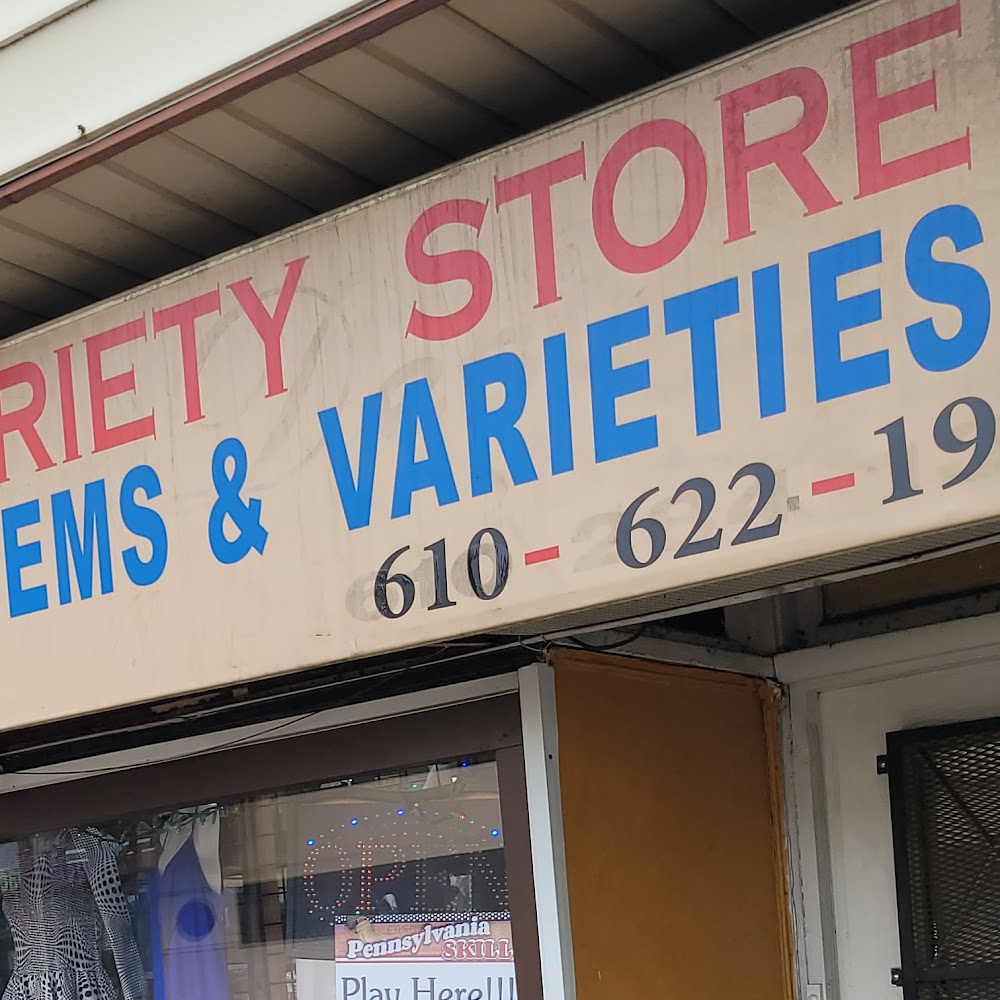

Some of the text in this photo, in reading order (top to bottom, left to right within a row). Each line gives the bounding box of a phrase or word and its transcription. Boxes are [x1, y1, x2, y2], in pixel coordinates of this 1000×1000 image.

[405, 2, 972, 341] STORE
[208, 437, 269, 565] &
[317, 204, 991, 530] VARIETIES
[346, 916, 490, 959] Pennsylvania
[441, 939, 514, 960] SKILL
